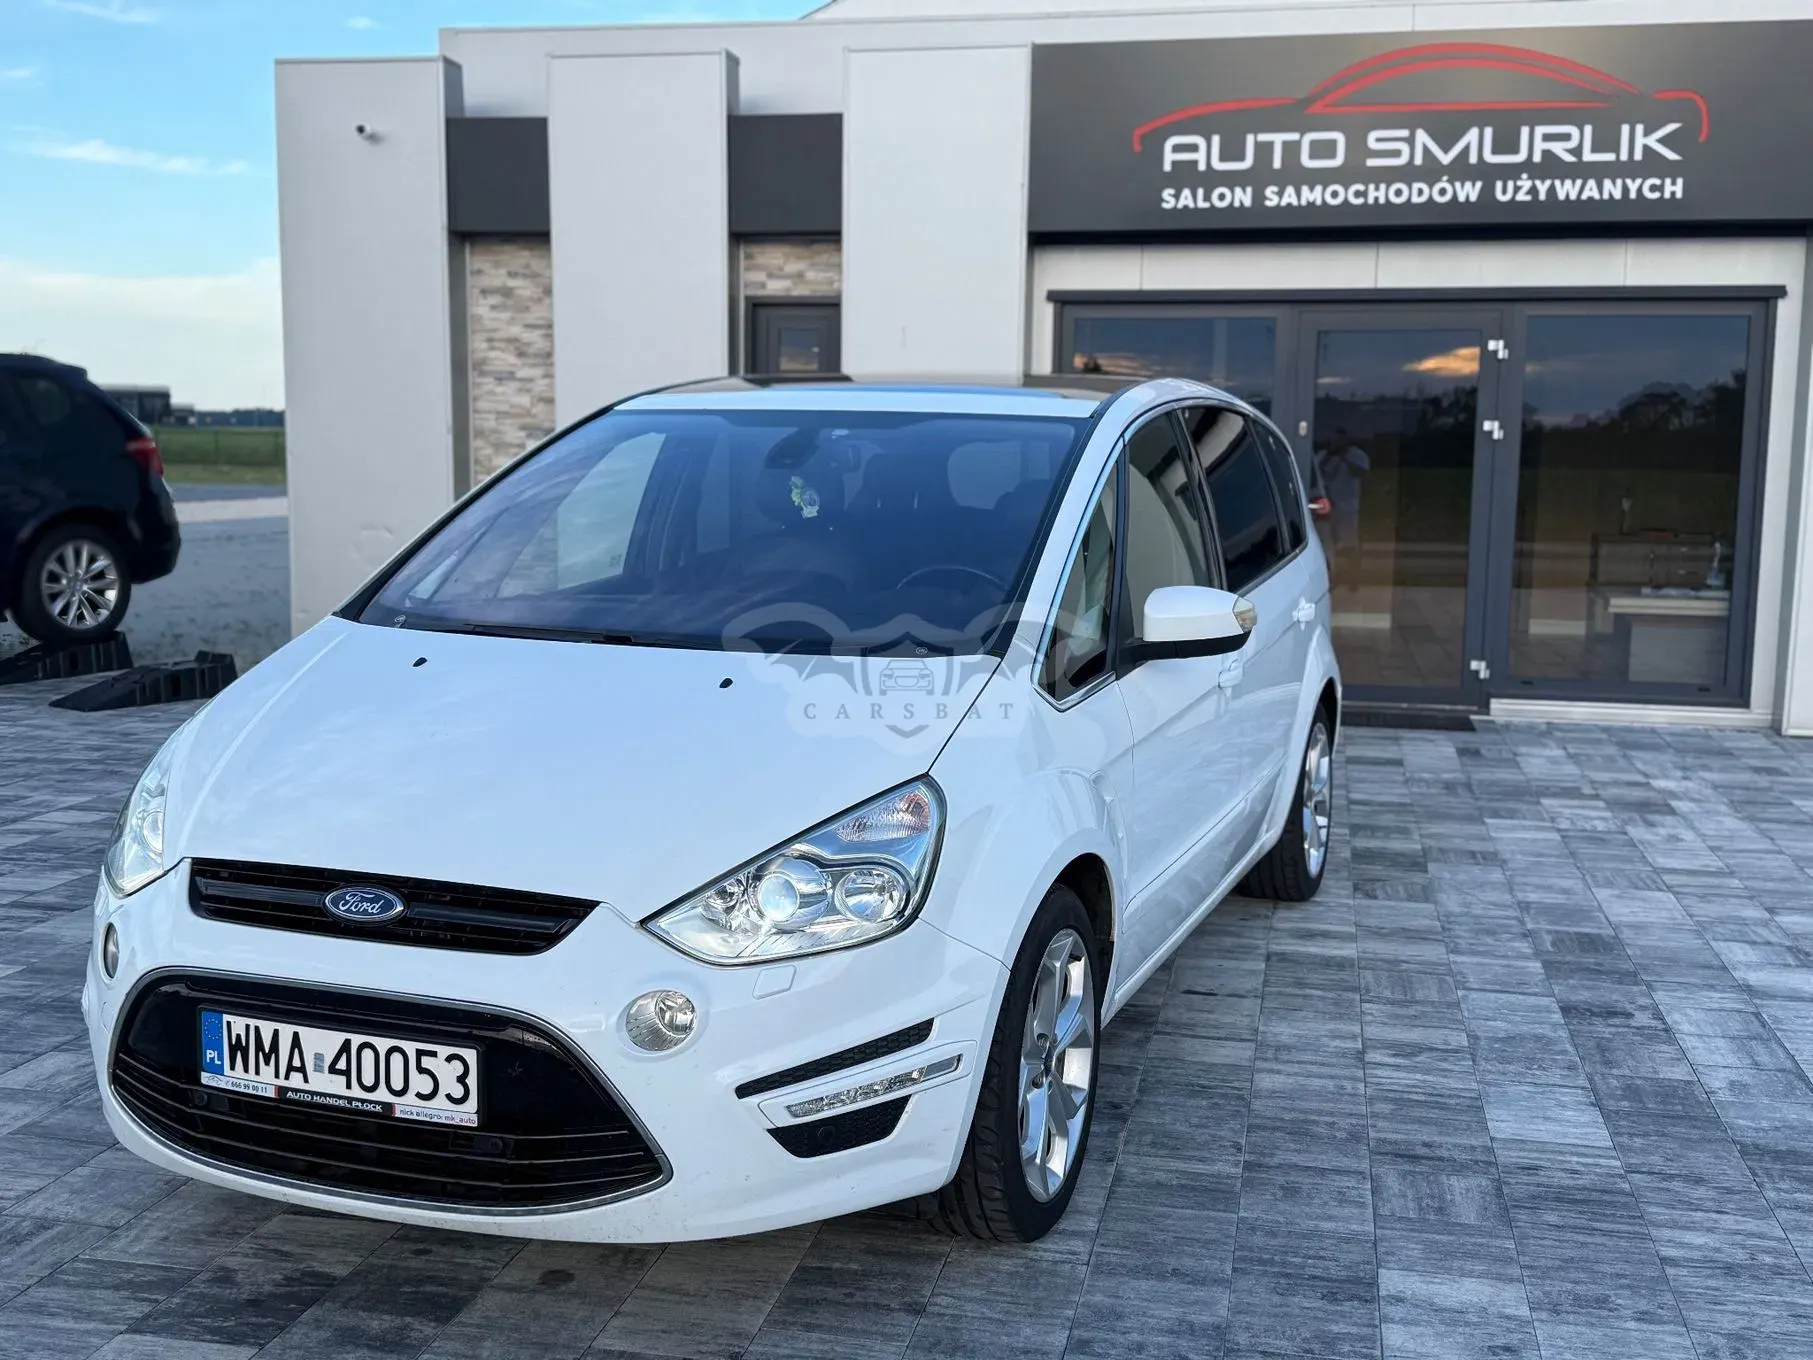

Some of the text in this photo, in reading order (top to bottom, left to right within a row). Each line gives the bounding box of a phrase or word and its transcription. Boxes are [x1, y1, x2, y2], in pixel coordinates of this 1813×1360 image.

[1163, 122, 1683, 173] AUTO SMURLIK
[1160, 172, 1684, 210] SALON SAMOCHODÓW UŻYWANYCH
[339, 891, 384, 914] Ford
[206, 1049, 221, 1065] PL
[226, 1020, 470, 1105] WMA 40053
[286, 1090, 382, 1113] AUTO HANDEL PŁOCK
